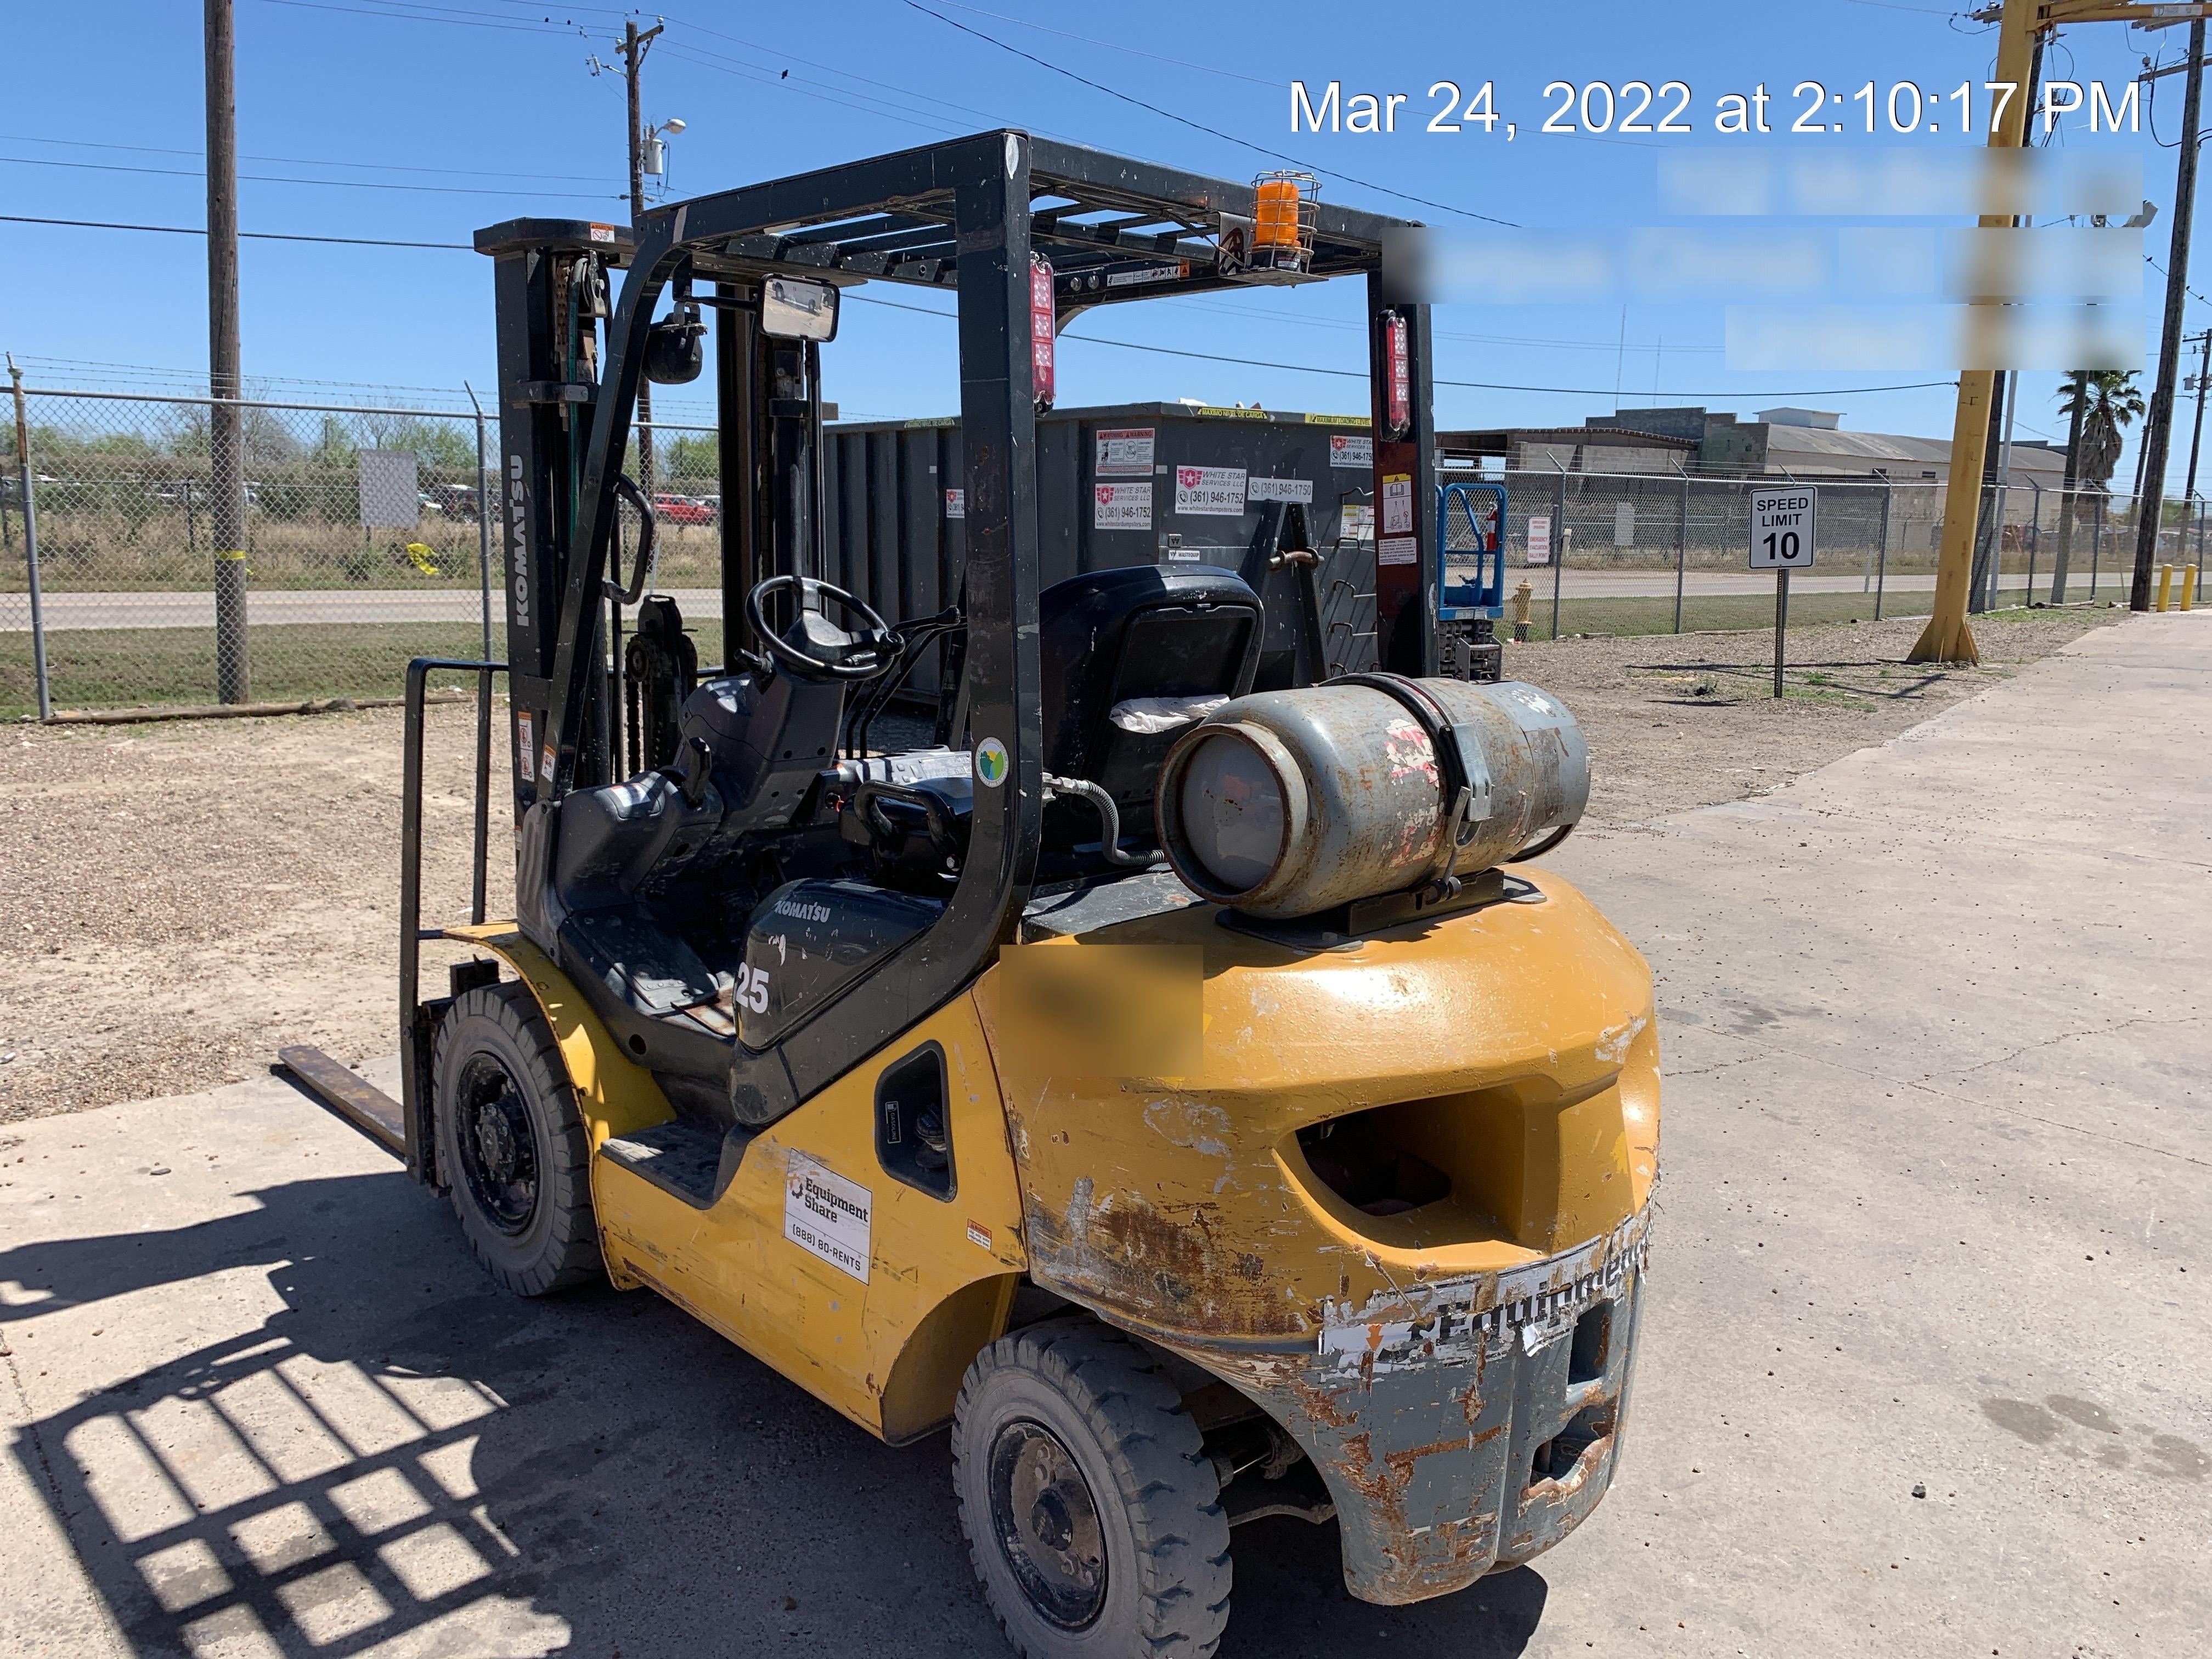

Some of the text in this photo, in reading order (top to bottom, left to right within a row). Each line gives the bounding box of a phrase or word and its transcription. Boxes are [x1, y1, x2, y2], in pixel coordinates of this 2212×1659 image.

[1340, 451, 1351, 461] (361)
[1190, 491, 1243, 505] (361) 946-1752
[1261, 483, 1311, 496] (361) 946-1750
[1105, 506, 1150, 520] (361) 946-1752
[1757, 497, 1809, 511] SPEED
[1762, 513, 1803, 527] LIMIT
[509, 455, 529, 627] KOMATSU
[1763, 531, 1800, 560] 10
[774, 900, 831, 923] KOMATSU
[736, 962, 769, 1013] 25
[805, 1177, 868, 1223] Equipment
[805, 1194, 838, 1223] Share
[793, 1223, 861, 1271] (888) 80-RENTS
